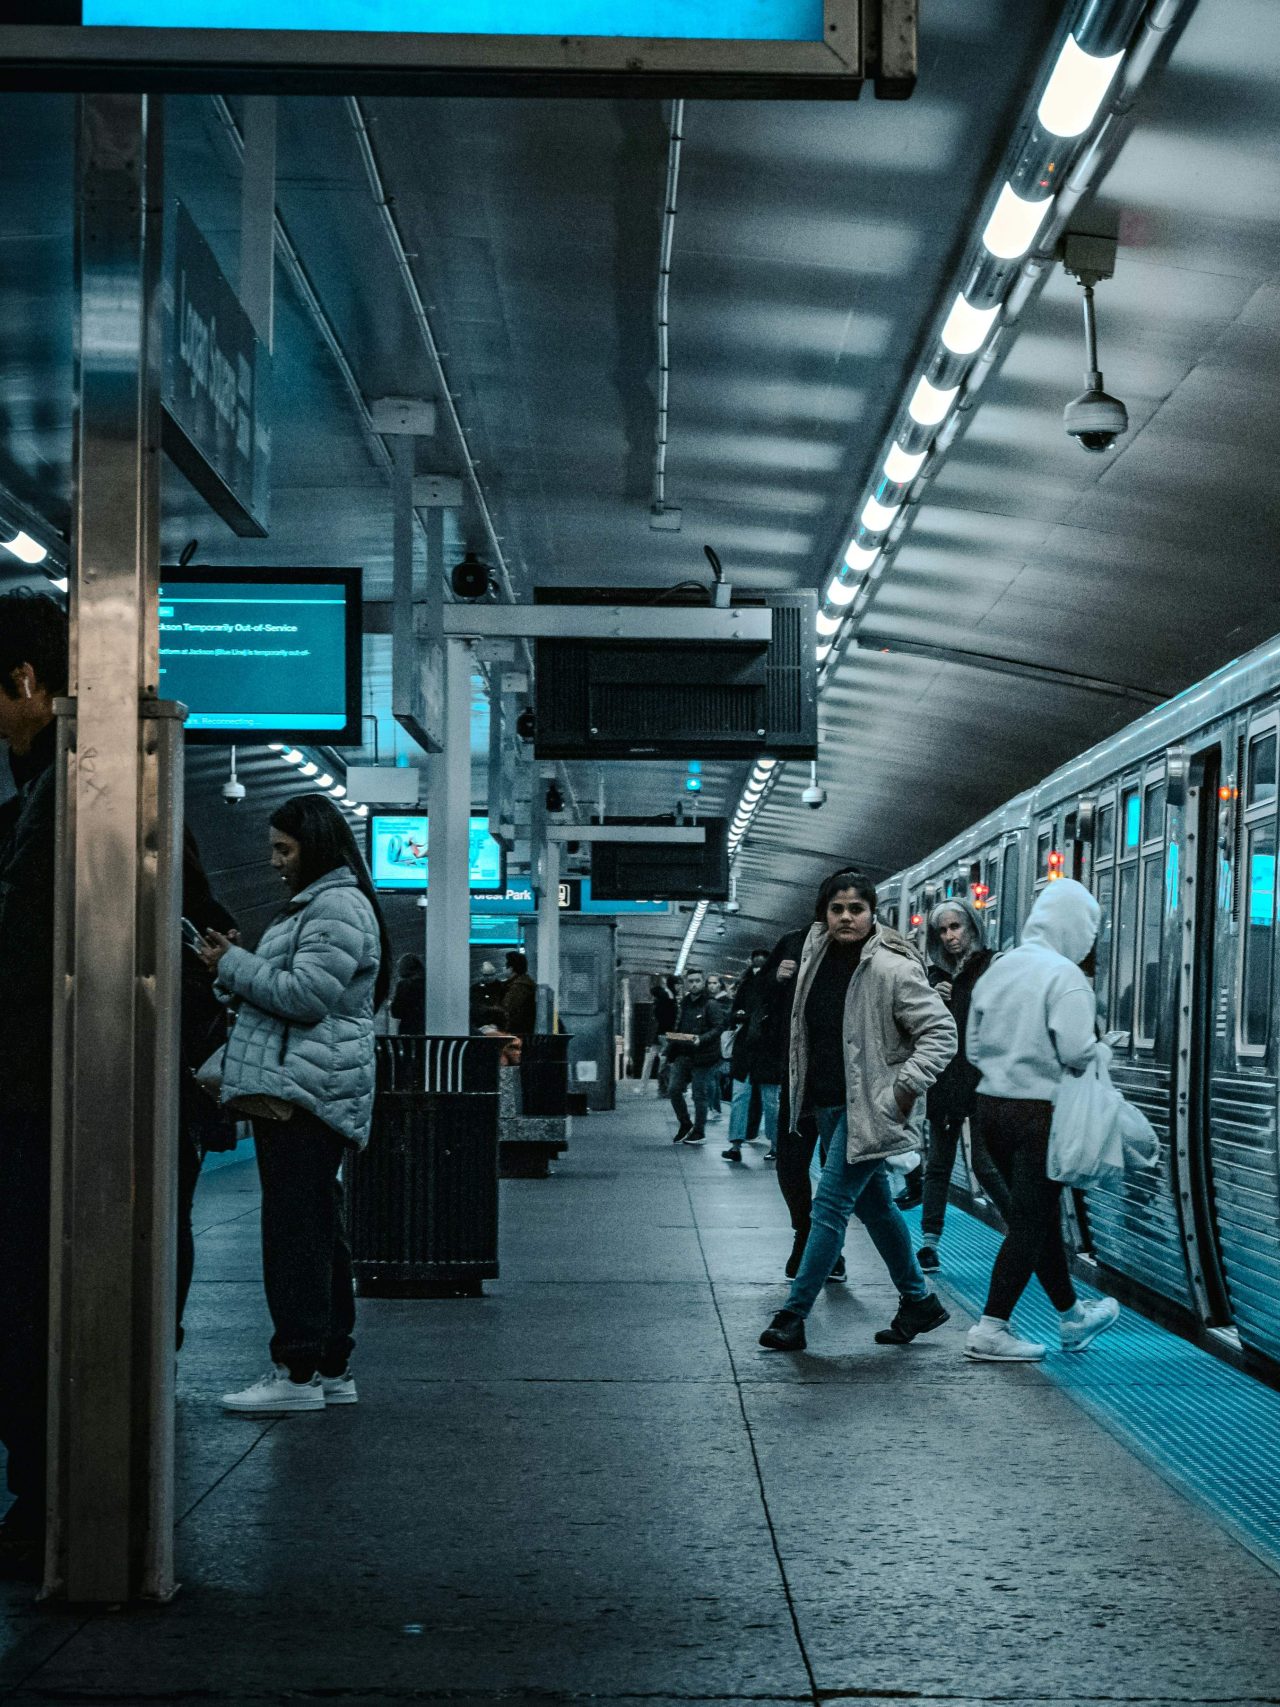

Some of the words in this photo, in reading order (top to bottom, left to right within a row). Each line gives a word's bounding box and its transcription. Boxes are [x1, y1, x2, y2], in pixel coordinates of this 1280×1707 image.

[182, 623, 233, 633] Temporarily
[235, 623, 298, 632] Out-of-Service
[506, 889, 532, 900] Park
